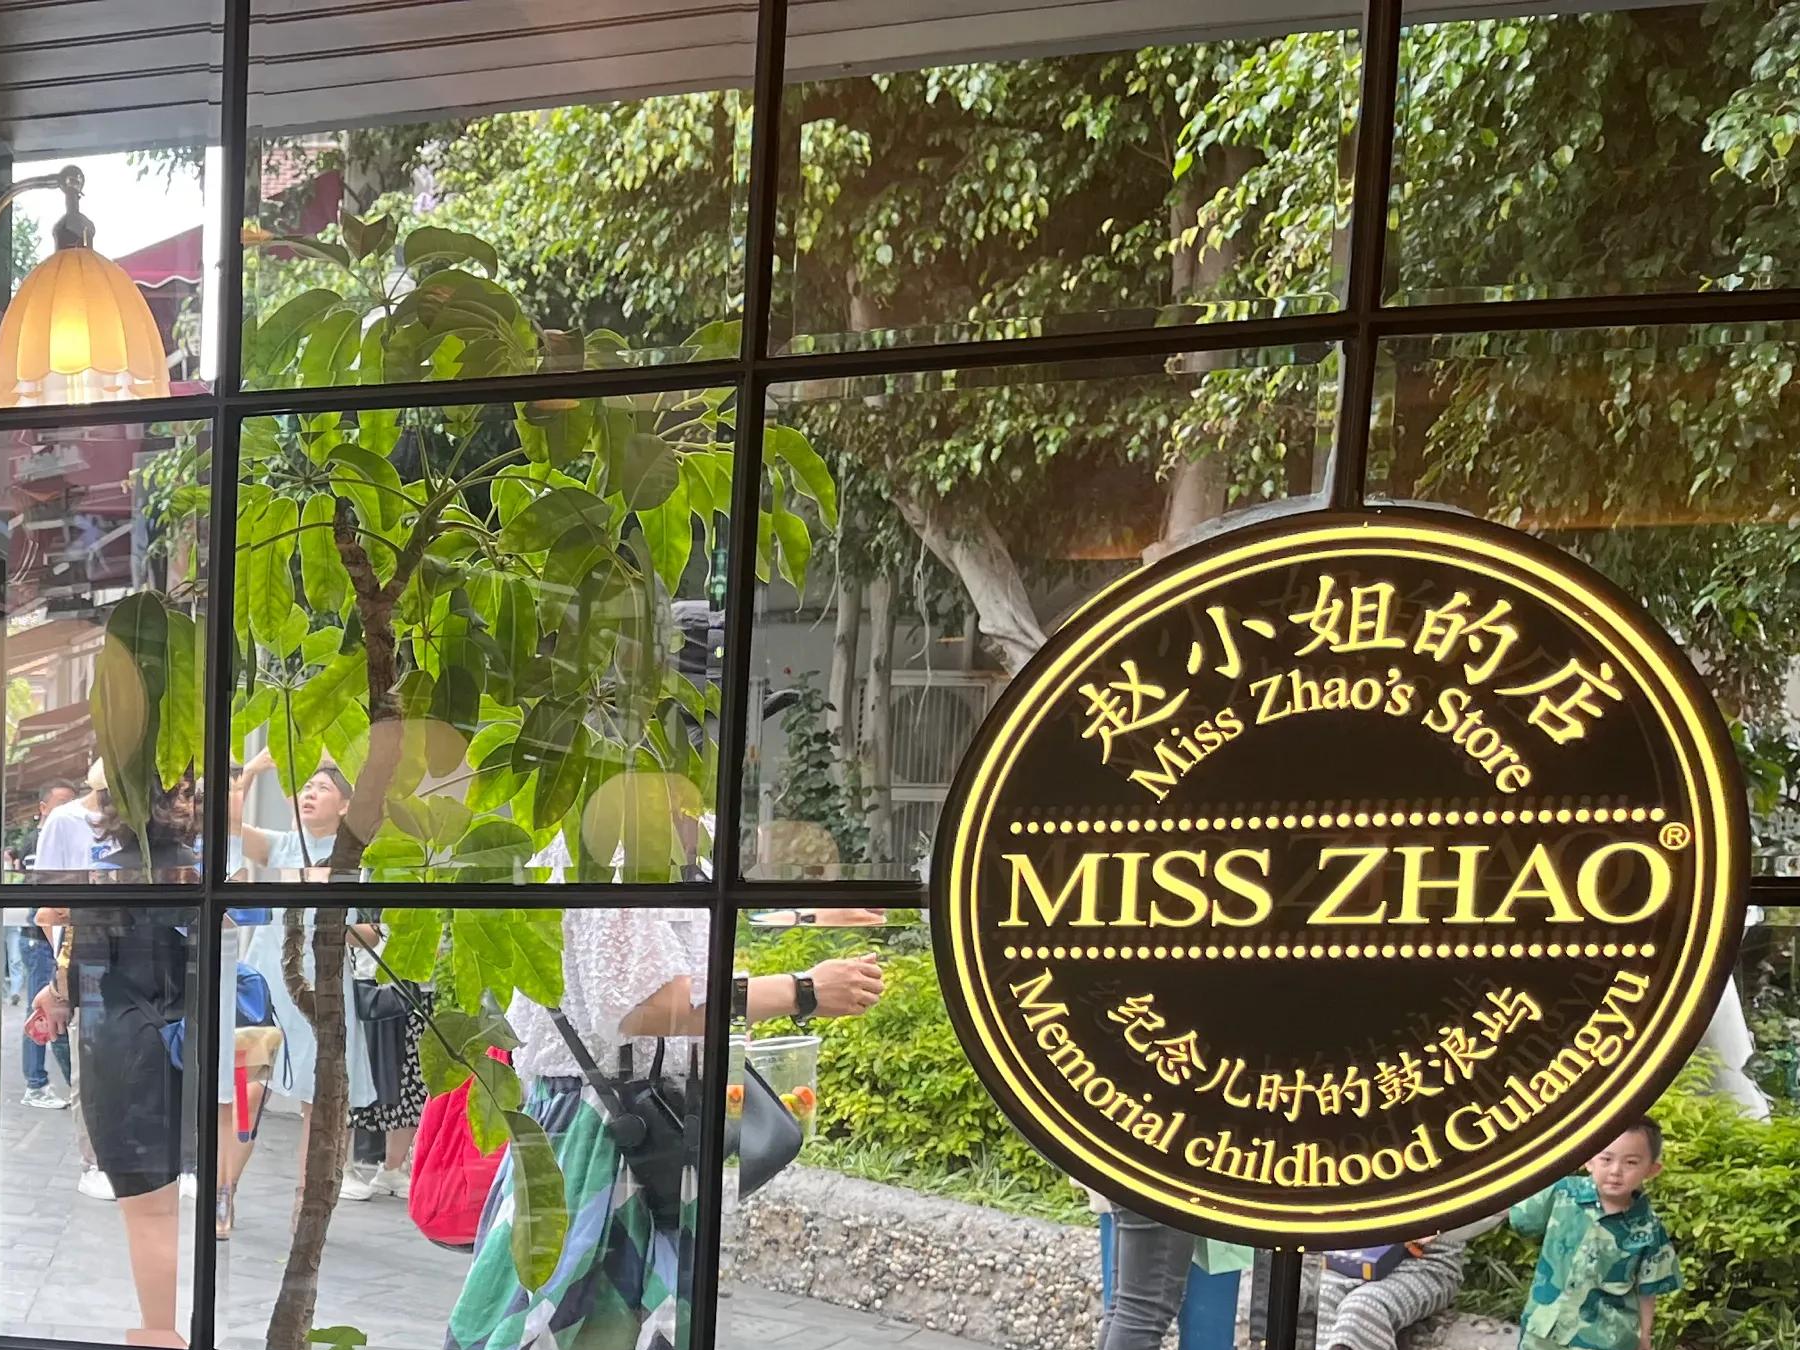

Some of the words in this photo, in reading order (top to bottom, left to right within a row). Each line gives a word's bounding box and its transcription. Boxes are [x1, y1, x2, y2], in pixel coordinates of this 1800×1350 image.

[1077, 574, 1625, 764] 赵小姐的店
[1127, 708, 1244, 801] Miss
[1249, 667, 1414, 725] Zhao's
[1421, 688, 1535, 794] Store
[997, 849, 1272, 928] MISS
[1307, 841, 1672, 925] ZHAO
[1008, 967, 1186, 1154] Memorial
[1185, 1124, 1442, 1188] childhood
[1444, 968, 1652, 1154] Gulangyu
[1106, 986, 1544, 1122] 纪念儿时的鼓浪屿
